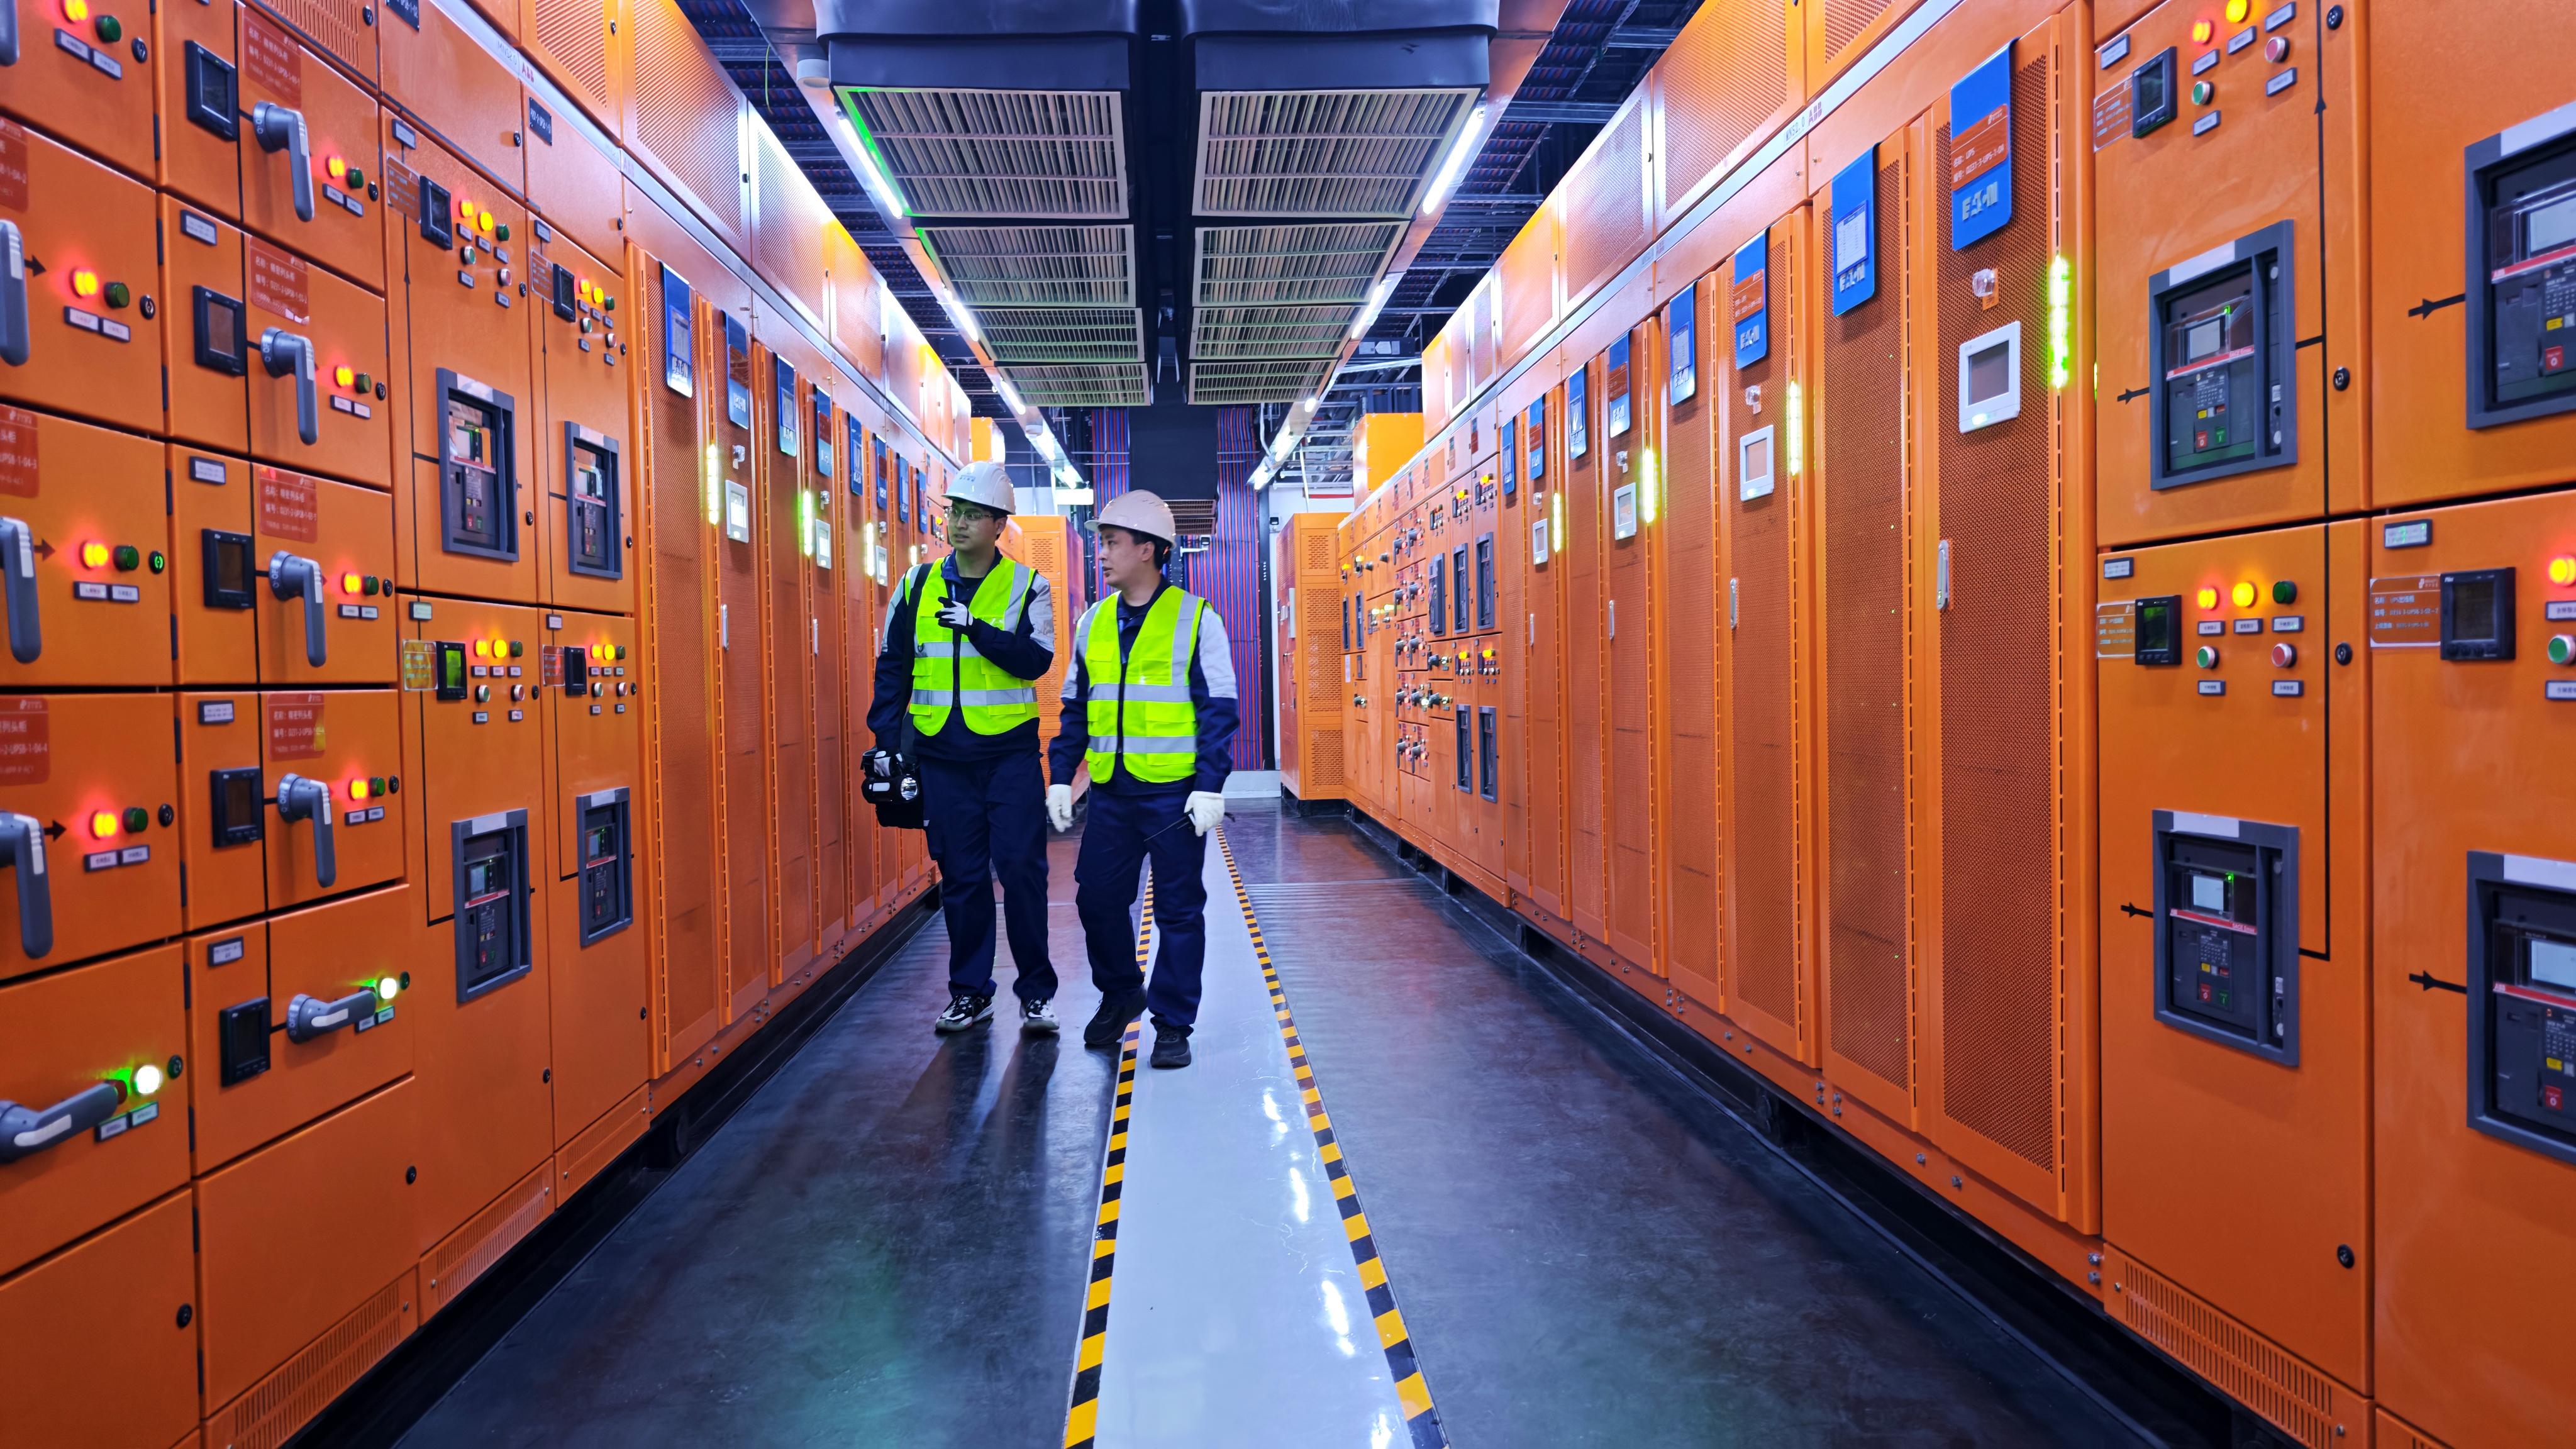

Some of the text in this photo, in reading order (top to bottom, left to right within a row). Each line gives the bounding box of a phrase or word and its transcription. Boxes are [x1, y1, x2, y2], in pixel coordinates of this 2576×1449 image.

[521, 63, 535, 83] ABB
[1808, 101, 1822, 126] ABB
[1962, 180, 1998, 221] EATON
